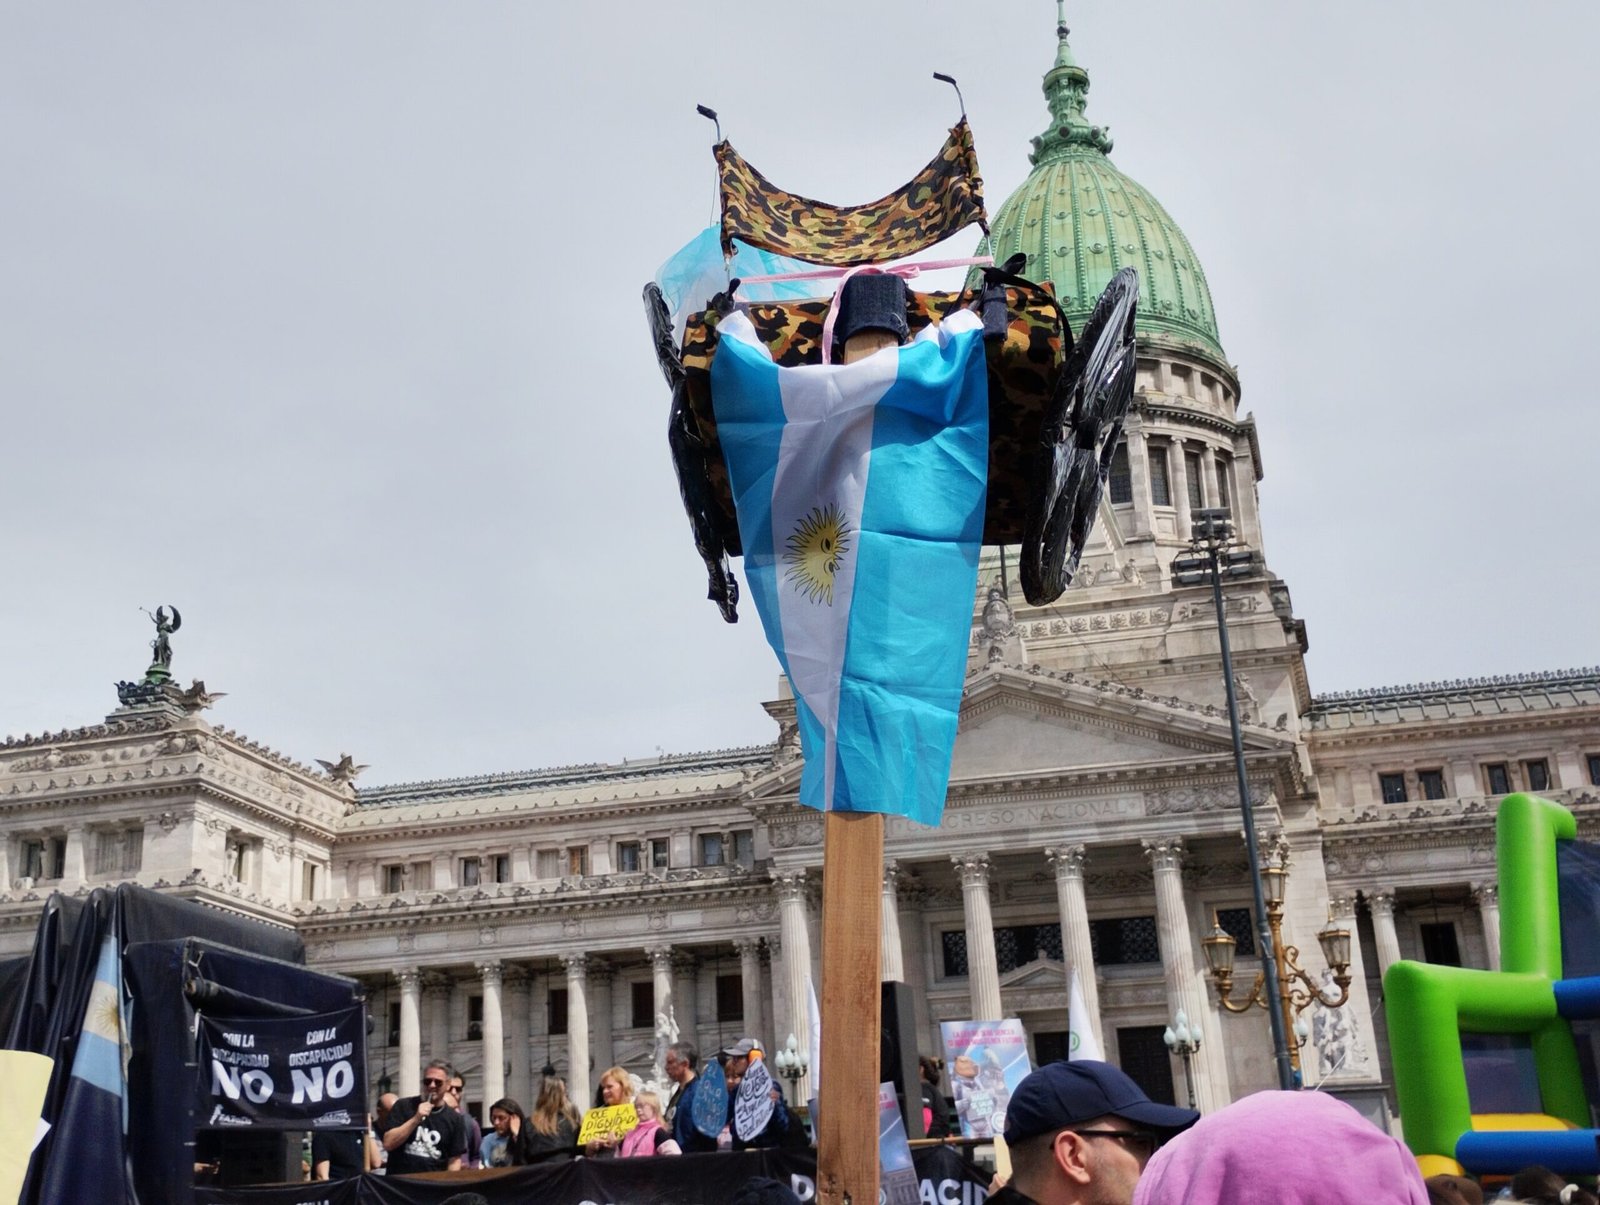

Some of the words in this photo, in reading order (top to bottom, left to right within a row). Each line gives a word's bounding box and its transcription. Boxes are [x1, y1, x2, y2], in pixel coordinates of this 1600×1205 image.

[1028, 800, 1127, 821] NACIONAL
[242, 1034, 255, 1048] LA
[306, 1029, 324, 1045] CON
[325, 1027, 336, 1041] LA
[289, 1042, 353, 1067] DISCAPACIDAD
[211, 1059, 274, 1104] NO
[290, 1060, 354, 1104] NO
[416, 1126, 441, 1145] NO
